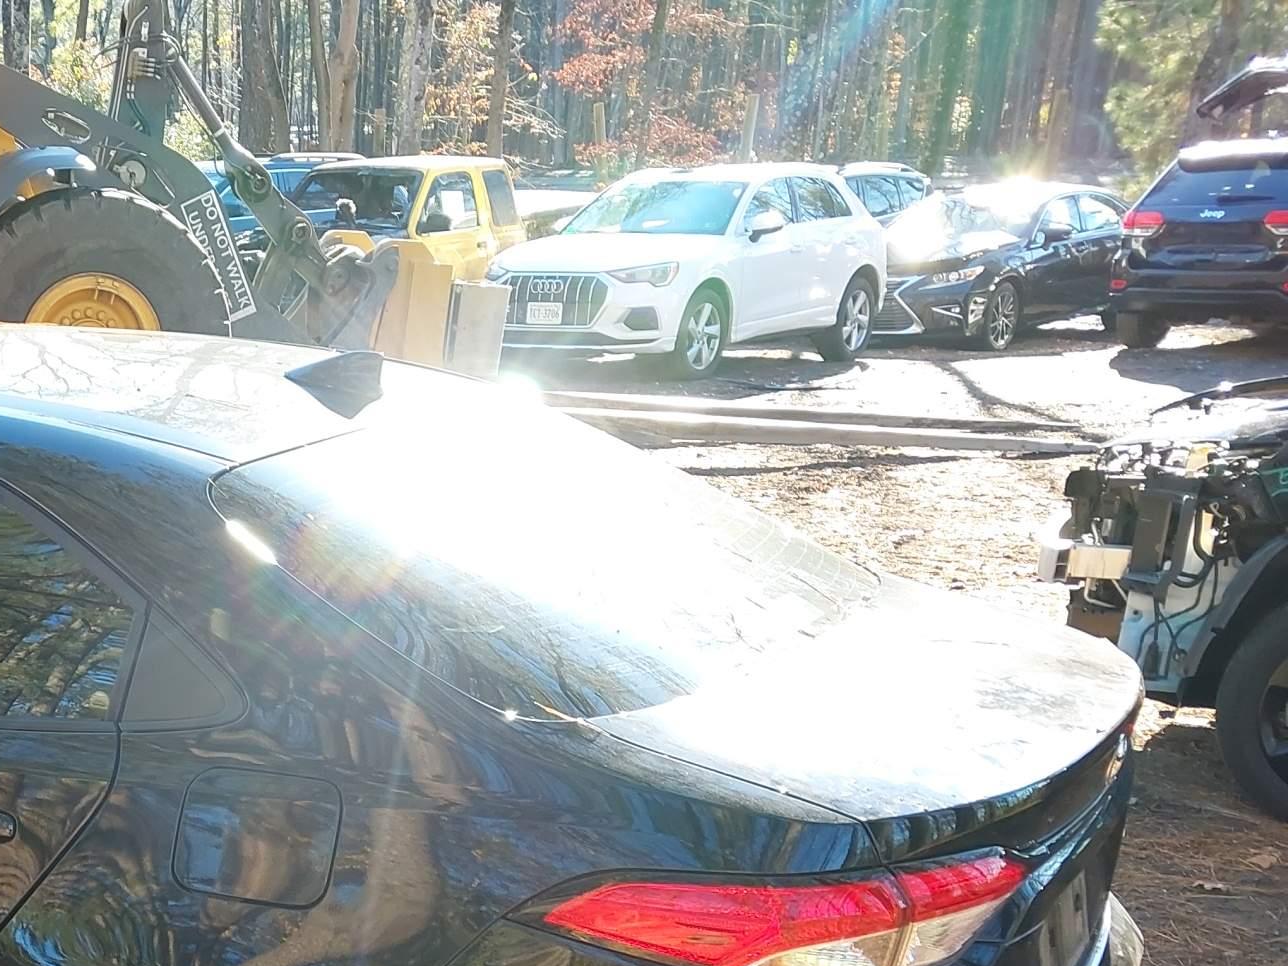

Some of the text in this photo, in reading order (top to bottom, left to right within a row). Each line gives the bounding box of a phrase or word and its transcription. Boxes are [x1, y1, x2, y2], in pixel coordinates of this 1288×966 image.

[1199, 208, 1225, 219] Jeep
[200, 194, 218, 220] DO
[211, 223, 232, 257] NOT
[227, 260, 252, 309] WALK
